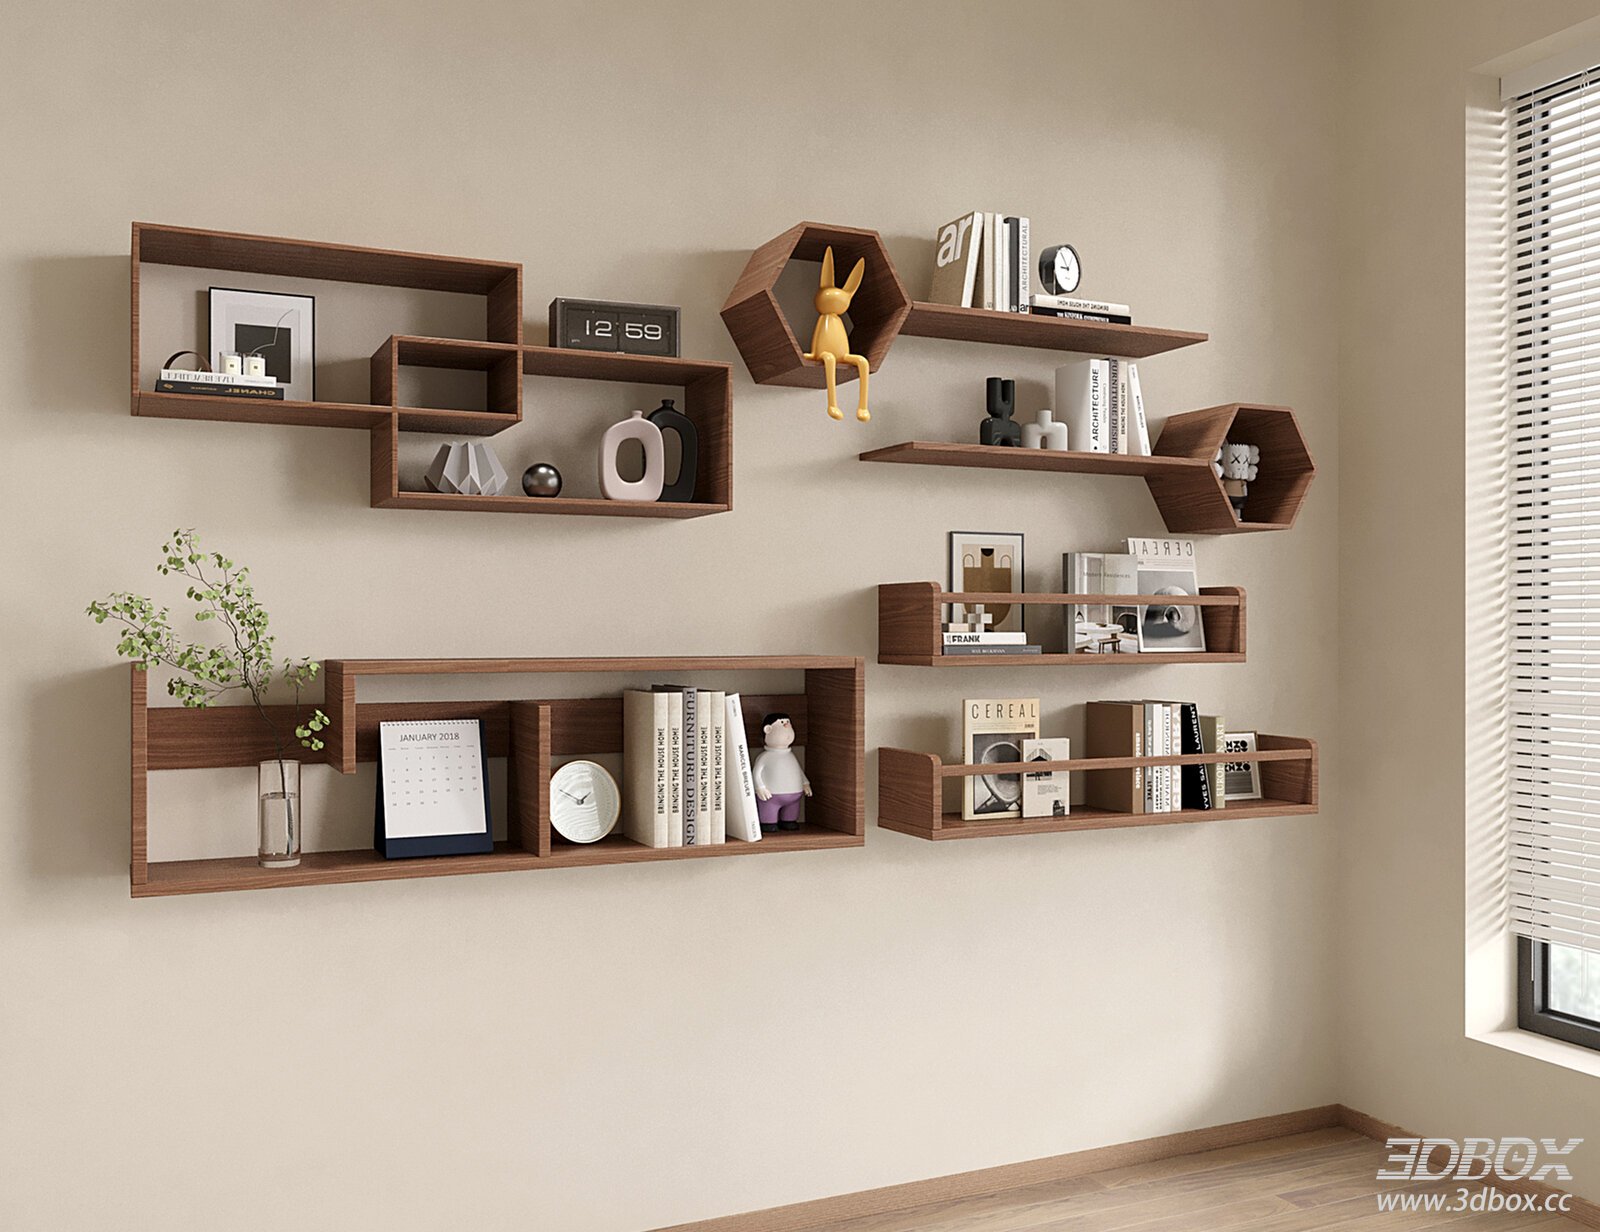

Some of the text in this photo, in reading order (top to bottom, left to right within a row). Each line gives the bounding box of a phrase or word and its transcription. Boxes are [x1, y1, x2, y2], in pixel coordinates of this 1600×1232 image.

[937, 214, 973, 268] ar
[1019, 303, 1029, 312] ar
[585, 319, 662, 340] 12 59
[952, 635, 980, 643] FRANK
[972, 704, 1036, 719] CEREAL
[400, 732, 460, 742] JANUARY 2018
[1190, 705, 1200, 750] LAURENT
[686, 690, 695, 846] FURNITURE DESIGN
[738, 744, 750, 797] MARCEL BREUER
[1216, 724, 1224, 796] EUROPN ART
[1202, 784, 1210, 809] YVES
